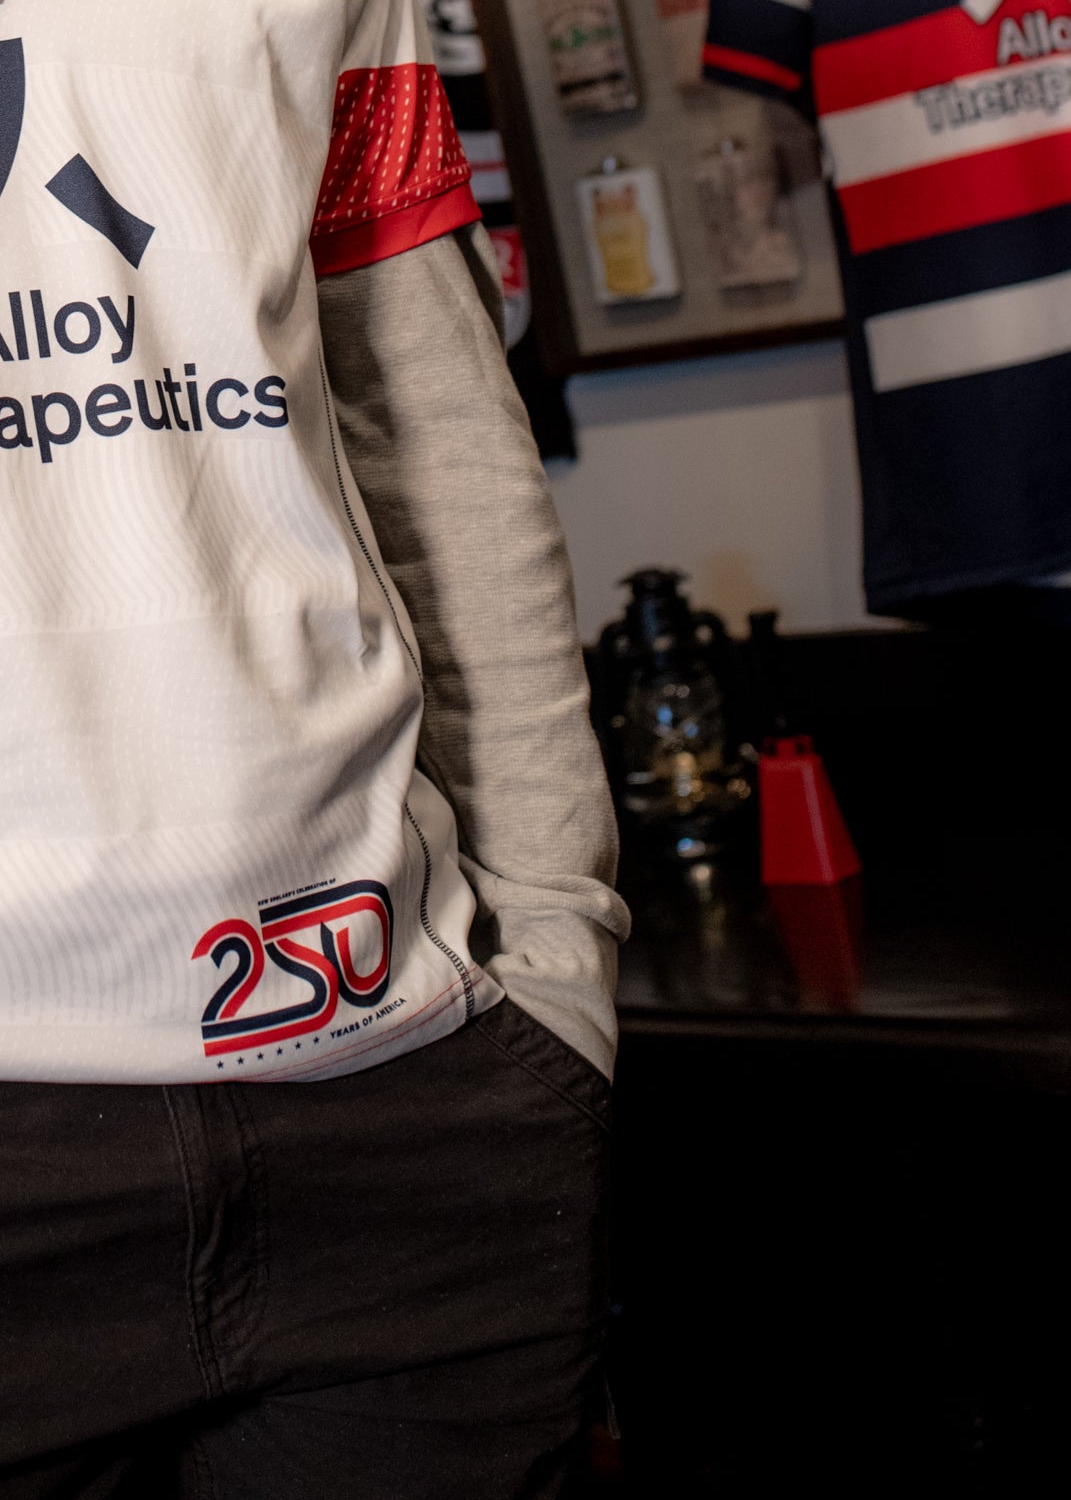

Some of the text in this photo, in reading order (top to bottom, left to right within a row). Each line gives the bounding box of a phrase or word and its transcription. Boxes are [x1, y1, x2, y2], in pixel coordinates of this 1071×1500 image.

[913, 68, 1071, 135] Therap
[190, 879, 394, 1058] 250
[330, 997, 407, 1039] YEARS OF AMERICA
